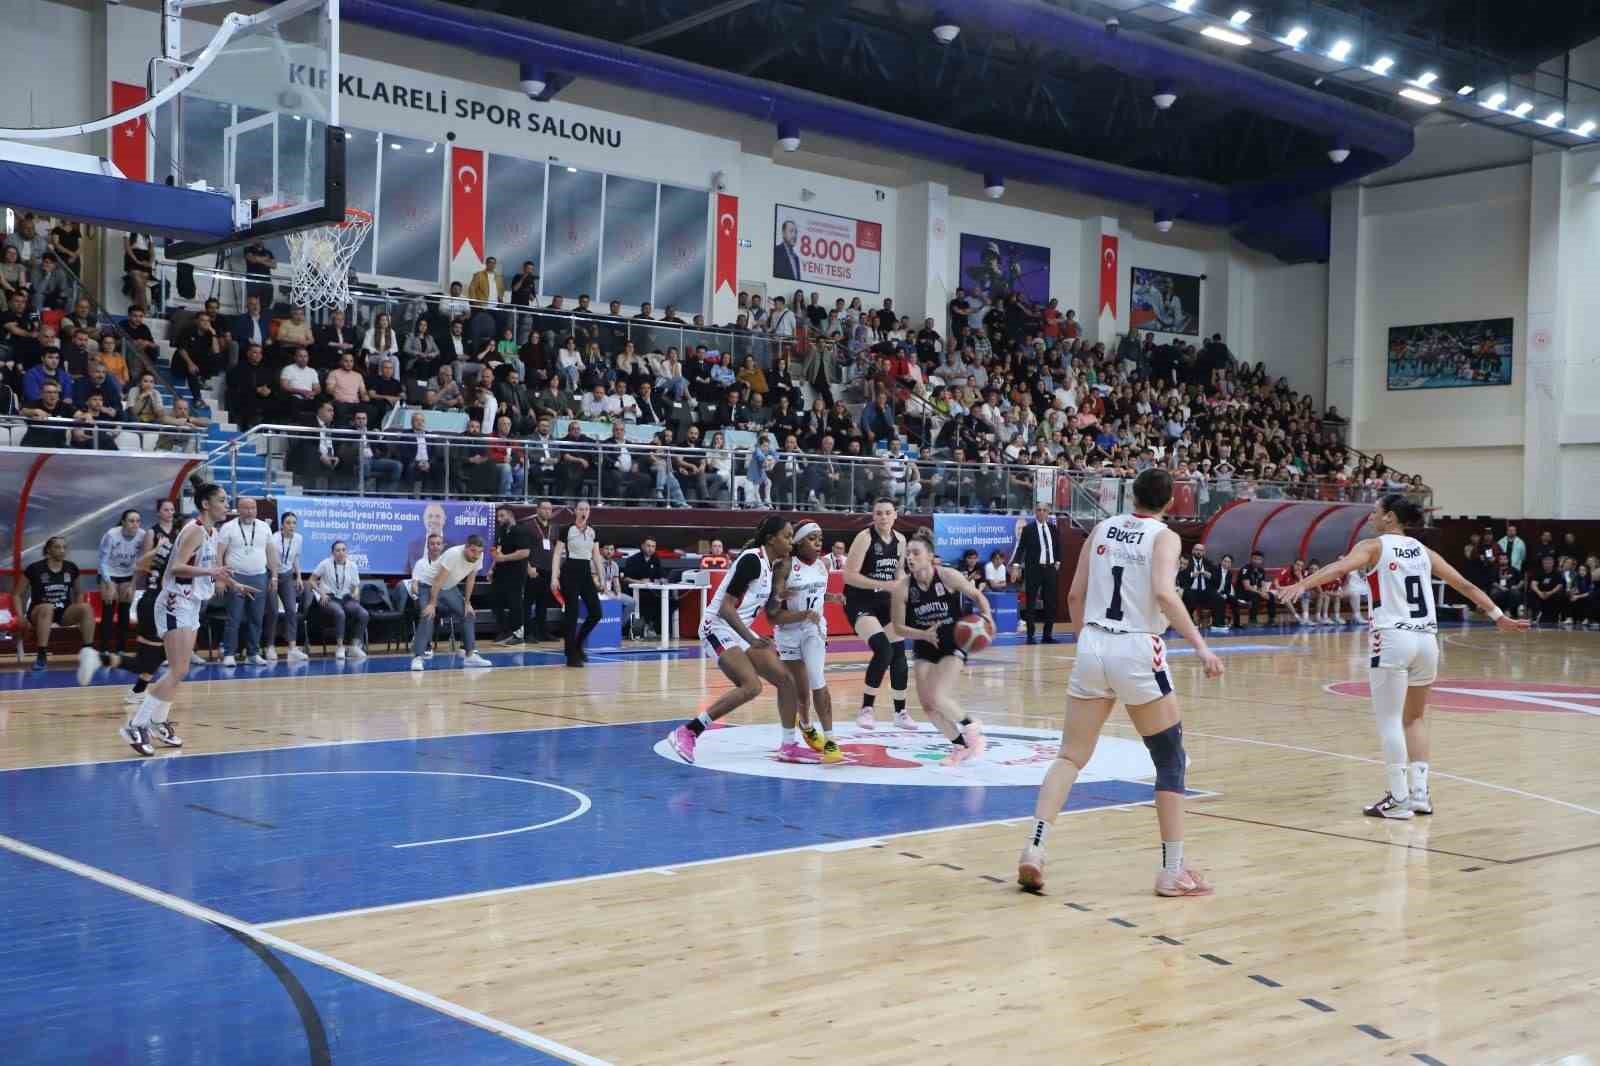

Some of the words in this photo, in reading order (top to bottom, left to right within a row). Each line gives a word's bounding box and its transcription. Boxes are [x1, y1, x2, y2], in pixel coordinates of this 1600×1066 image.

[455, 98, 521, 129] SPOR
[527, 113, 622, 148] SALONU
[800, 235, 855, 264] 8.000
[802, 261, 824, 274] YENİ
[304, 519, 349, 530] Basketbol
[1105, 565, 1124, 621] 1
[1404, 575, 1428, 618] 9
